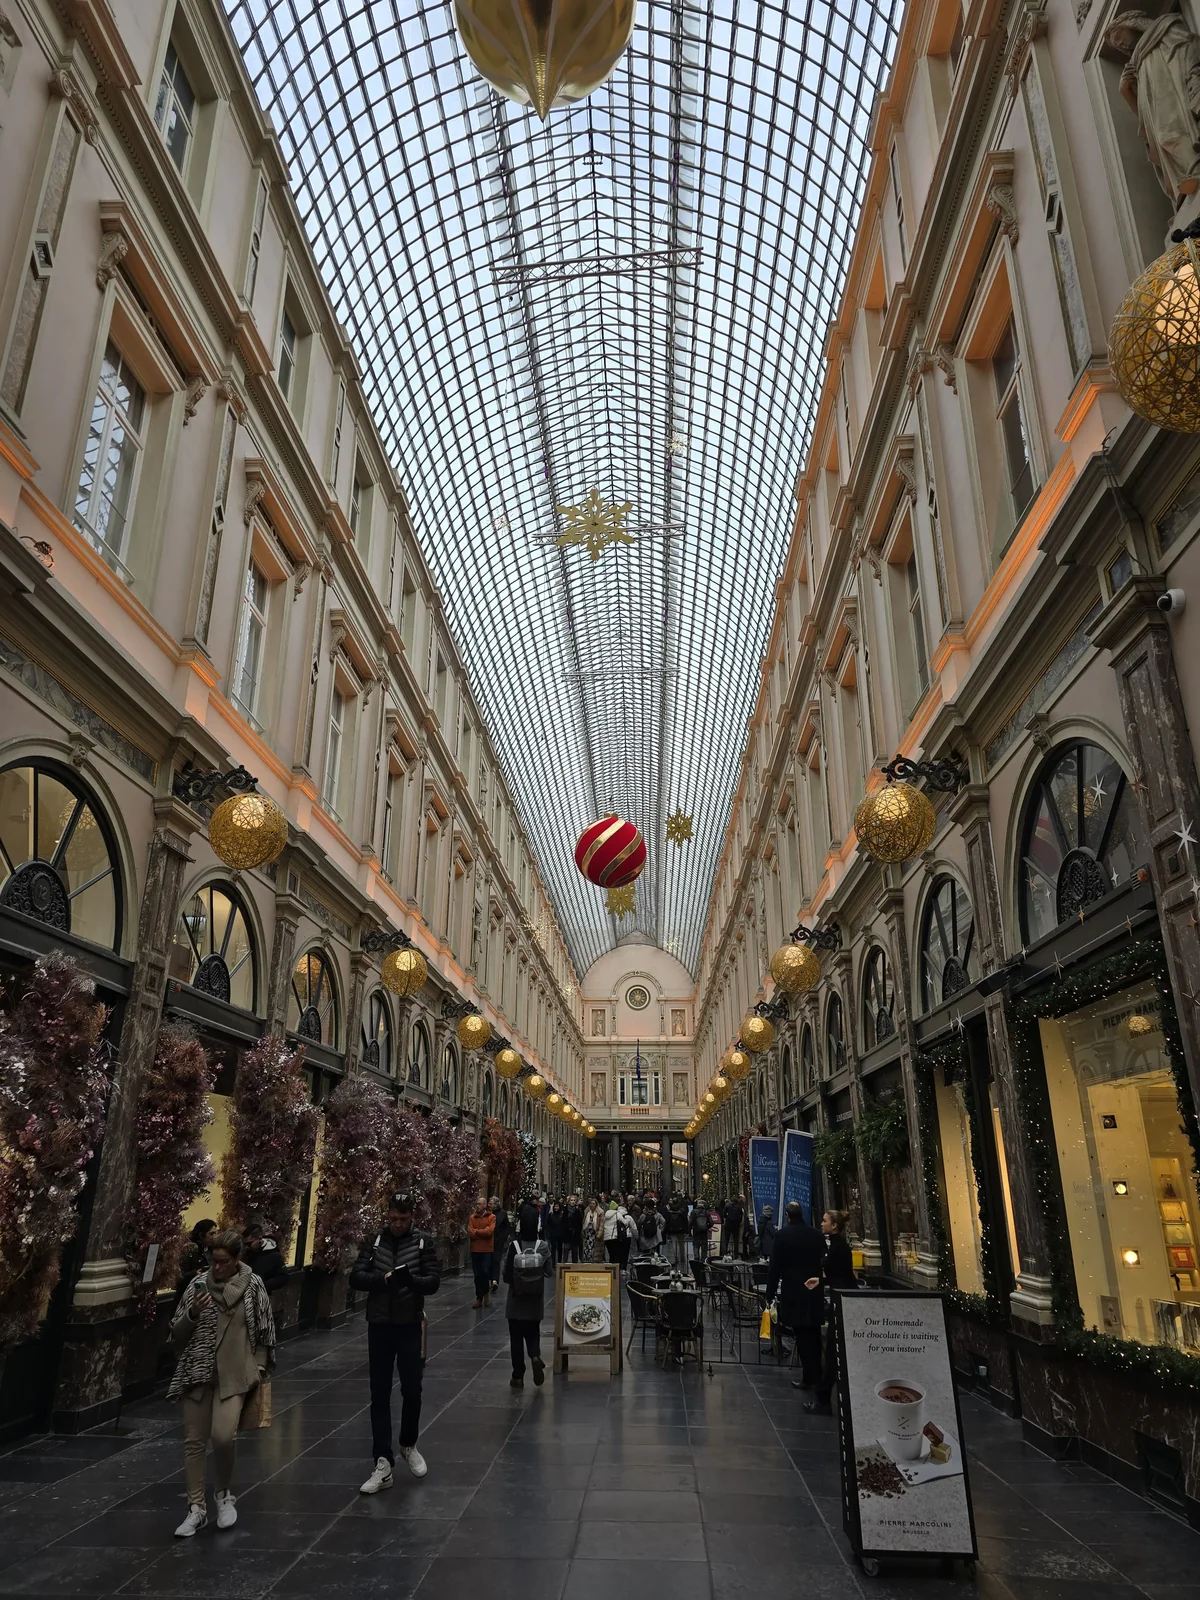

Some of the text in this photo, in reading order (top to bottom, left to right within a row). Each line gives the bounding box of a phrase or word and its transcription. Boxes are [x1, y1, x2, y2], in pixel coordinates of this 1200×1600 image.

[865, 1317, 924, 1327] Our Homemade
[852, 1330, 865, 1338] hot
[866, 1330, 900, 1339] chocolate
[910, 1332, 939, 1342] waiting
[868, 1343, 926, 1354] for you instore!
[879, 1519, 952, 1528] PIERRE MARCOLINI
